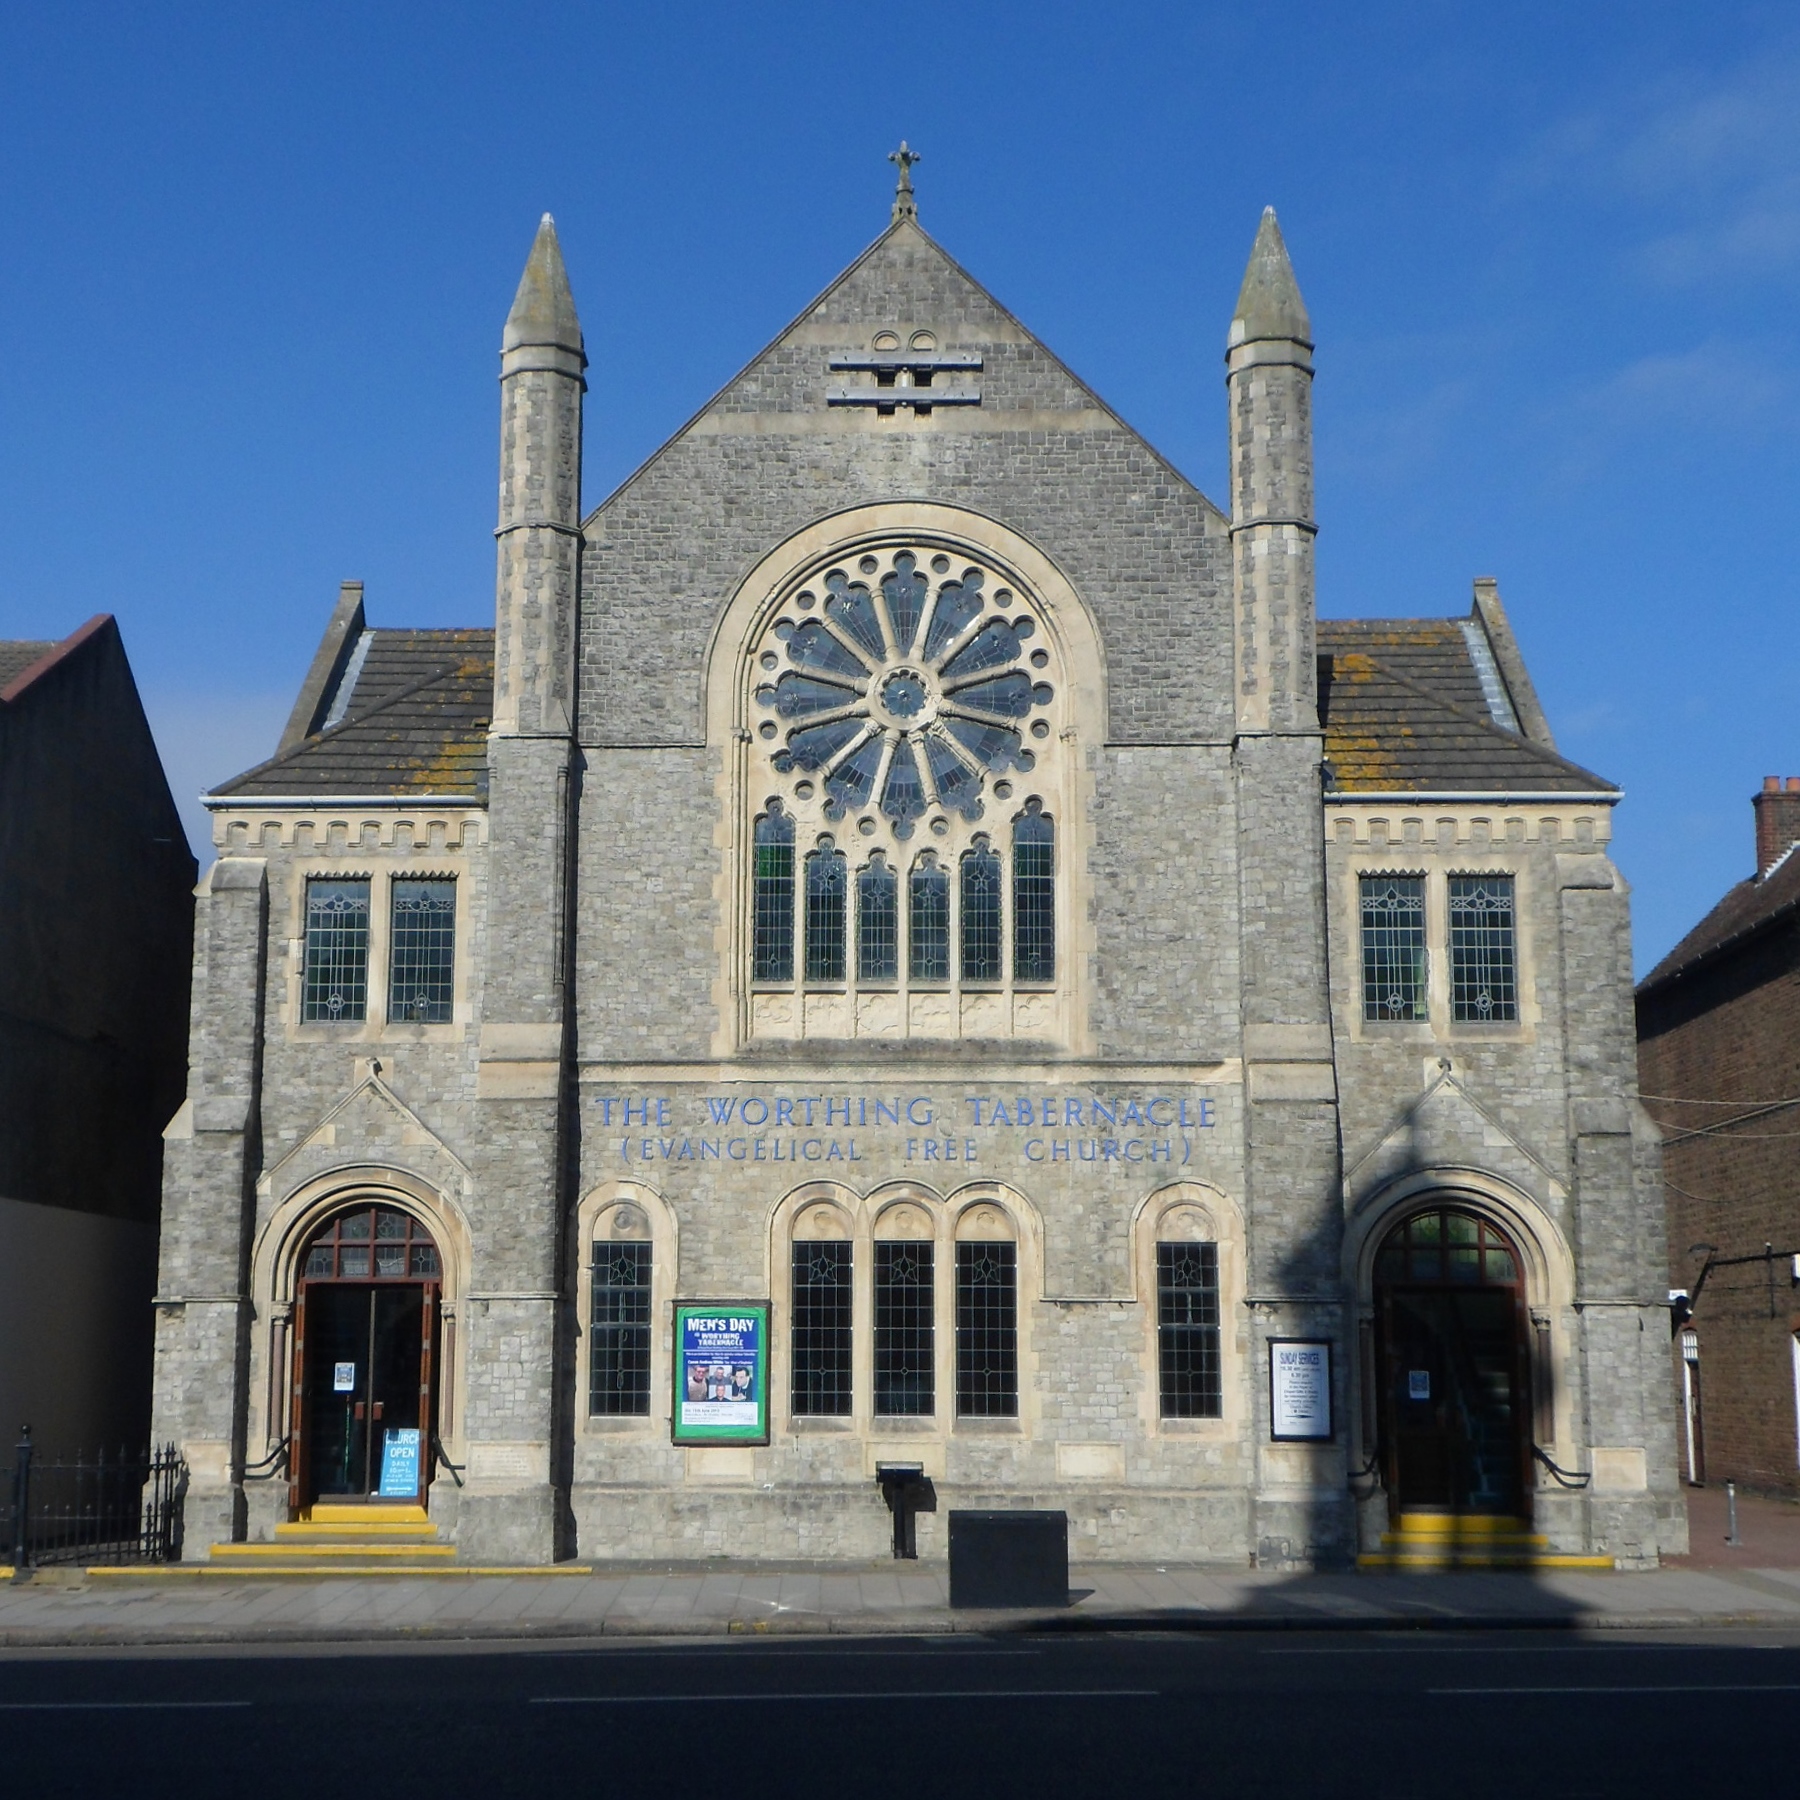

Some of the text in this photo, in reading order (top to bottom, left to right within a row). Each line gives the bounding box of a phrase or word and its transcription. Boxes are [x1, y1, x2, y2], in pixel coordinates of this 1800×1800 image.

[595, 1096, 1216, 1127] THE WORTHING TABERNACLE
[621, 1135, 1191, 1165] (EVANGELICAL FREE CHURCH)
[687, 1318, 755, 1333] MEN'S DAY
[390, 1447, 415, 1458] OPEN
